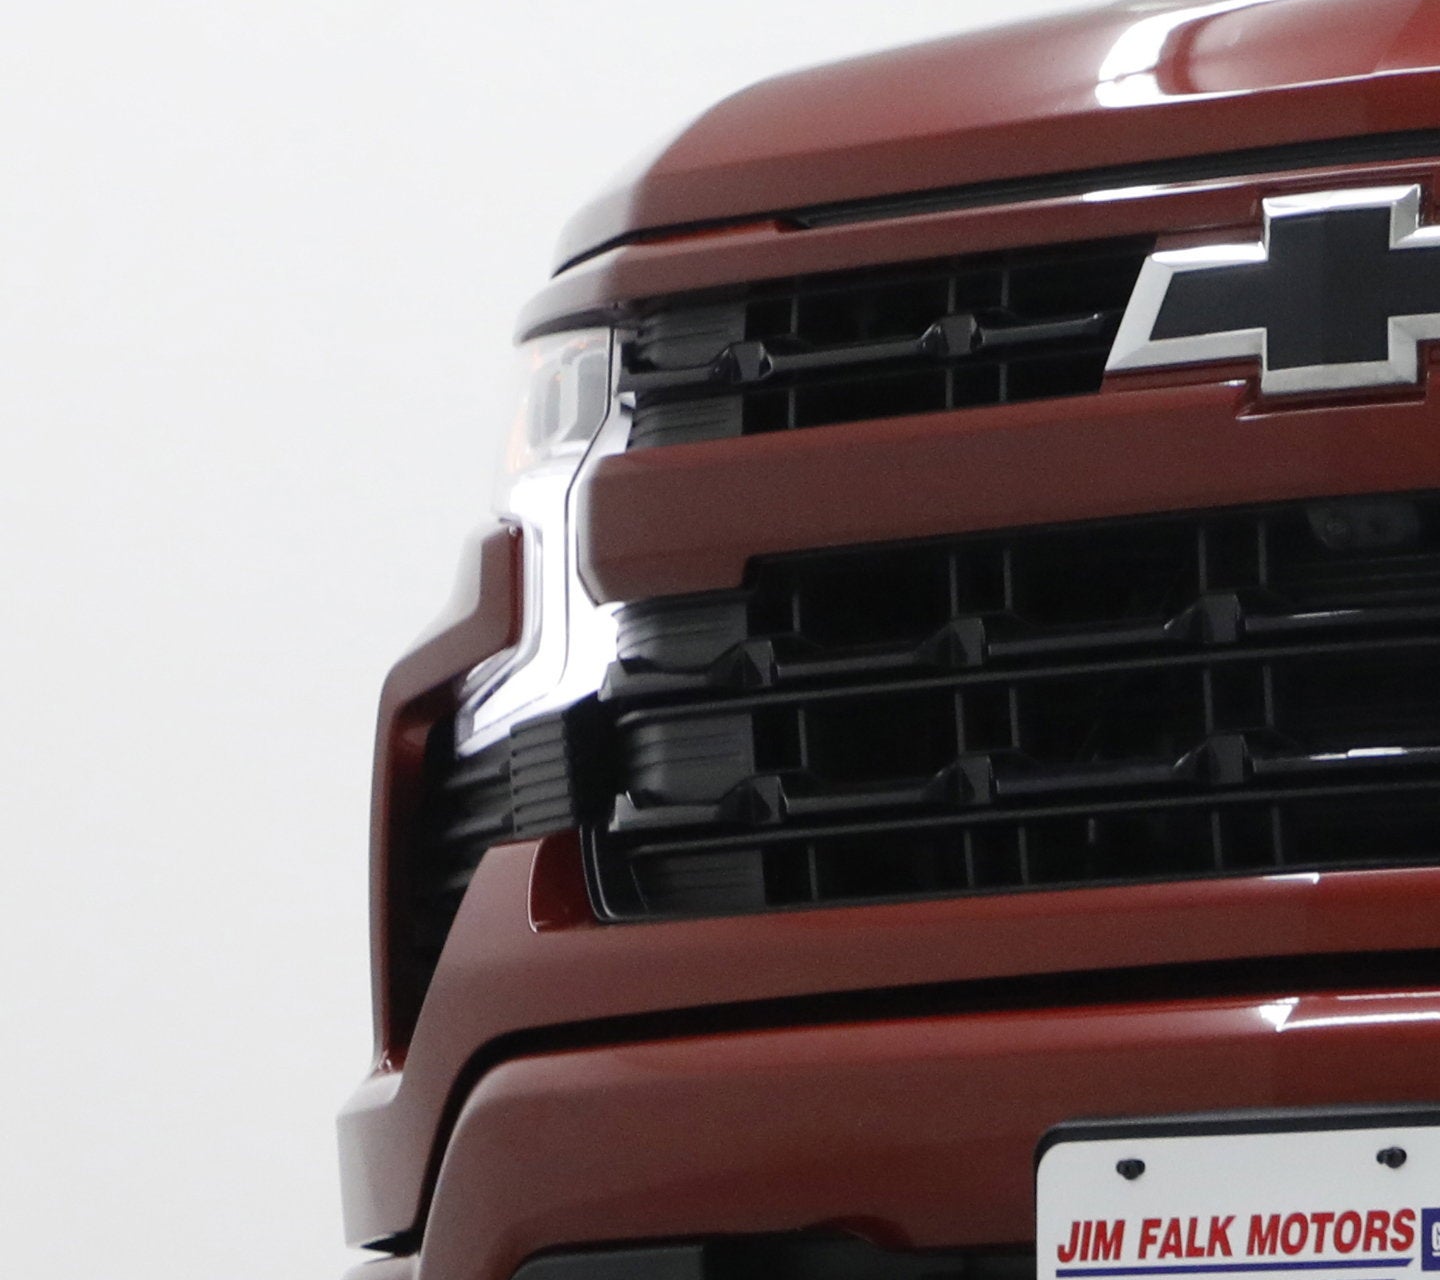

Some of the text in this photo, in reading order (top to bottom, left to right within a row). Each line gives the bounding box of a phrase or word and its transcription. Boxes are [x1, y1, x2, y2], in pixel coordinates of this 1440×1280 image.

[1057, 1208, 1417, 1264] JIM FALK MOTORS
